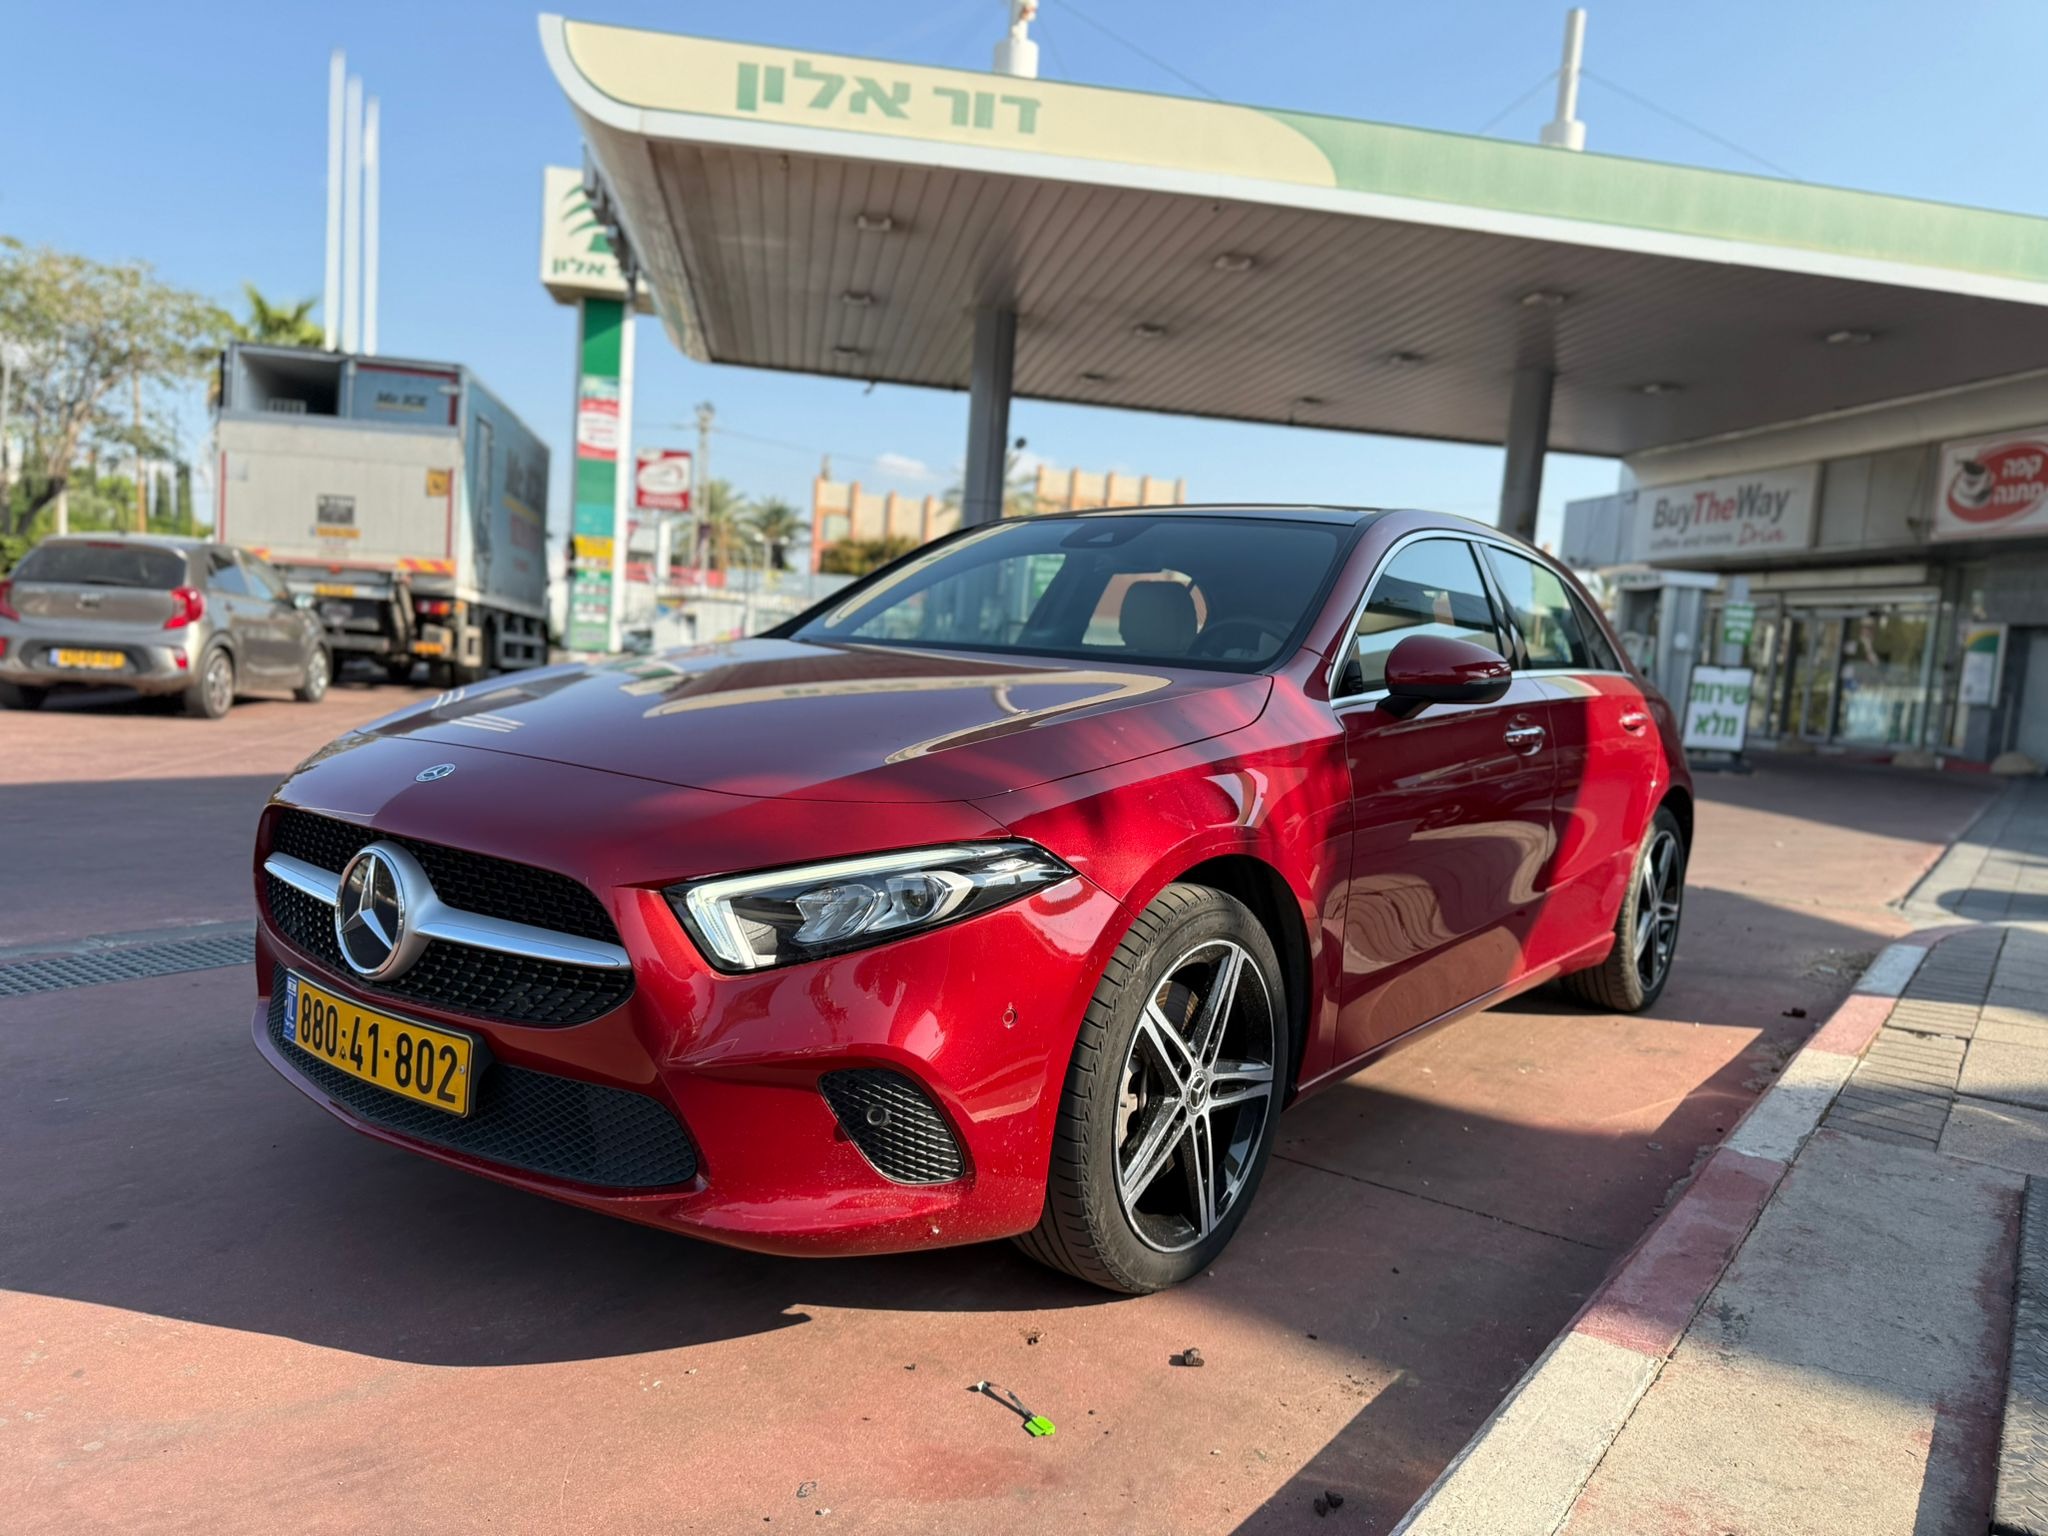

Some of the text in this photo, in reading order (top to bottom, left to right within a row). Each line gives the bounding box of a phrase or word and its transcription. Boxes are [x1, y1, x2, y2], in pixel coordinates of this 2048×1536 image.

[736, 59, 1042, 135] דור אלון
[2002, 455, 2043, 481] קפה
[1694, 709, 1738, 737] מלא
